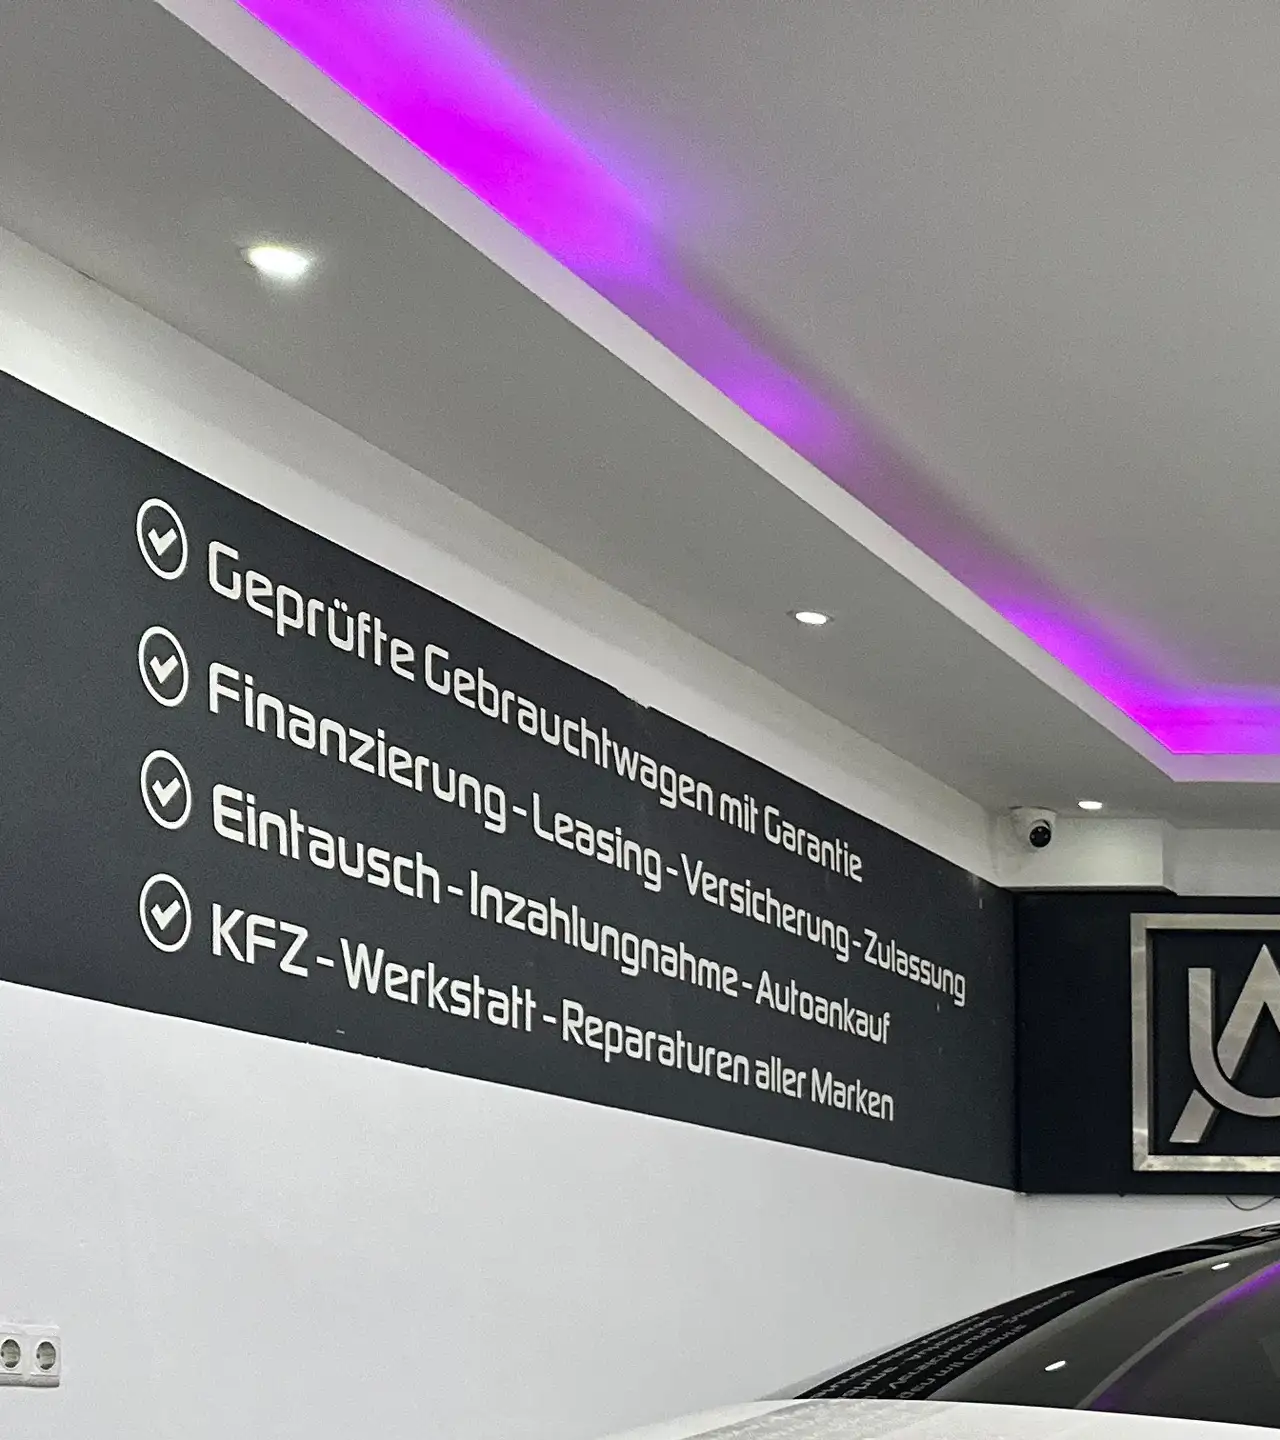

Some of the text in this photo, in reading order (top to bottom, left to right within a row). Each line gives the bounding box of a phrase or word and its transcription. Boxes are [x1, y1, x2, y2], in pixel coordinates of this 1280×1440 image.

[208, 541, 863, 883] Geprüfte Gebrauchtwagen mit Garantie
[863, 928, 966, 1008] Zulassung
[755, 970, 891, 1045] Autoankauf
[755, 1056, 807, 1099] aller
[811, 1066, 894, 1122] Marken
